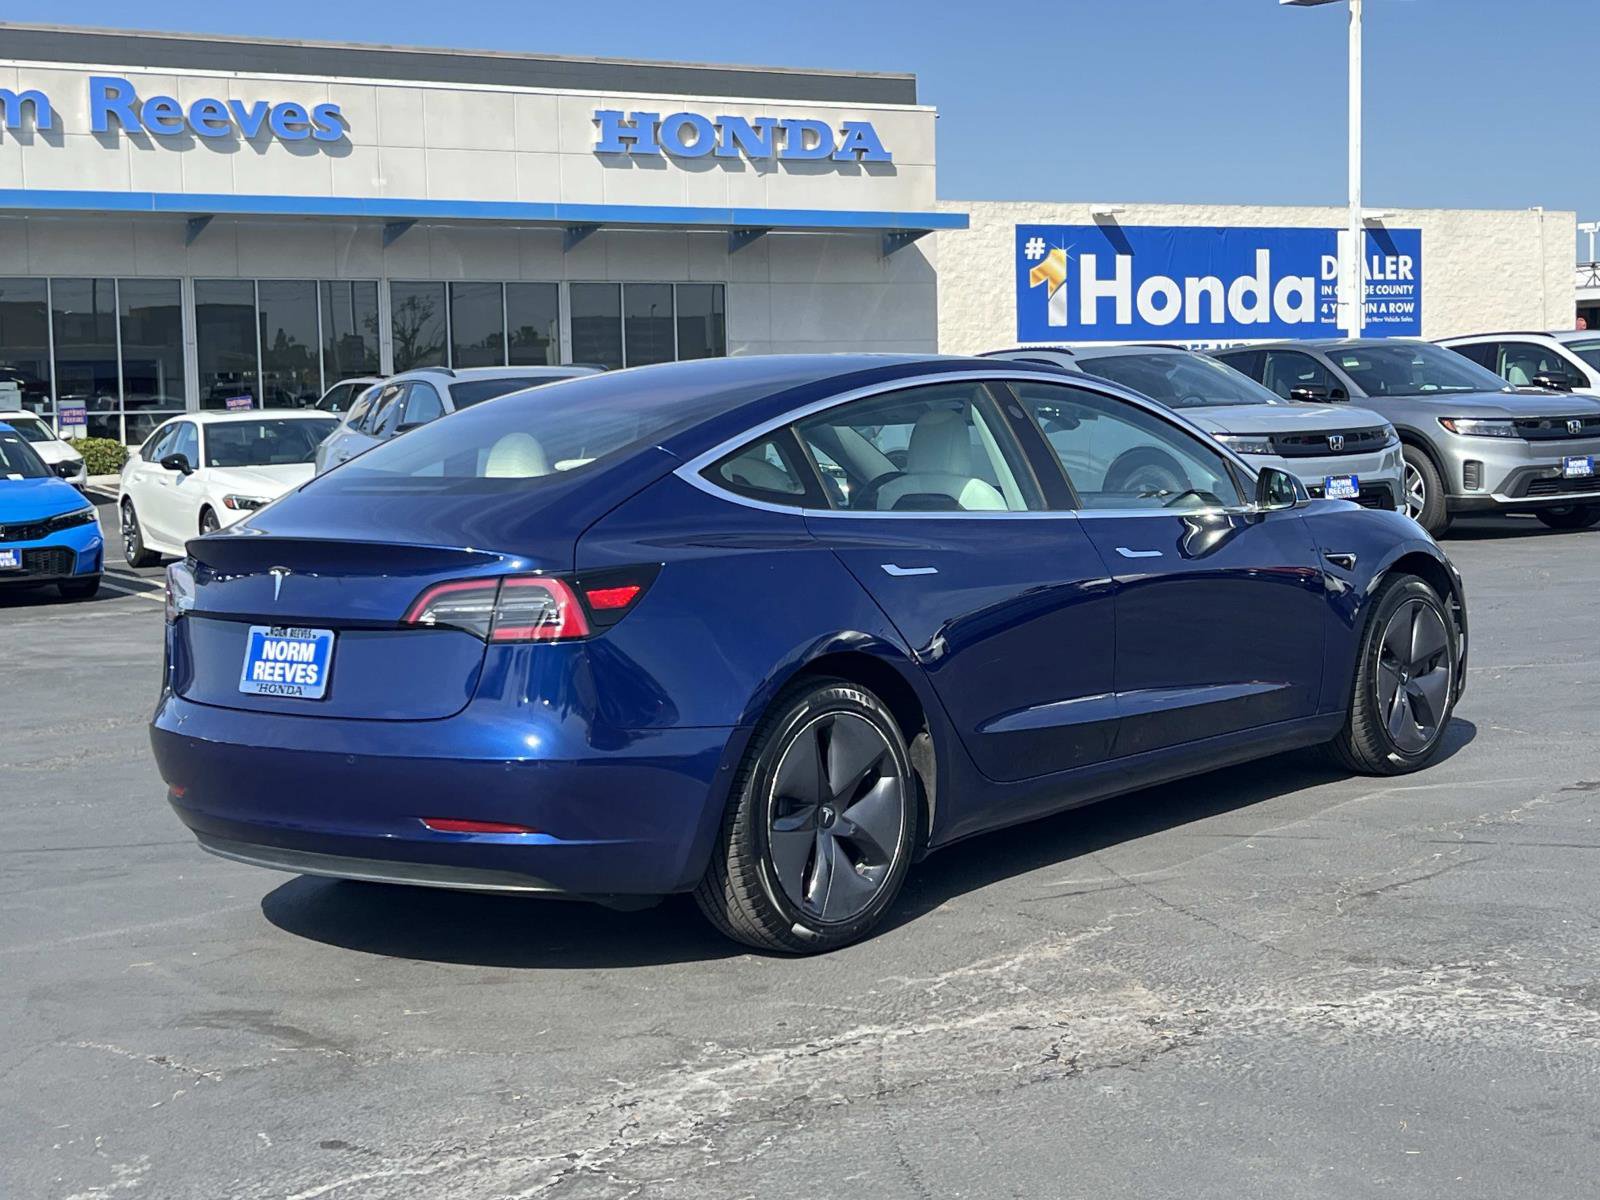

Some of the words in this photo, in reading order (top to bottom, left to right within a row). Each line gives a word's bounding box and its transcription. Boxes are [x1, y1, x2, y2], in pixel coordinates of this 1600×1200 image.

[89, 76, 345, 142] Reeves
[594, 110, 893, 162] HONDA
[1080, 249, 1315, 326] Honda
[1321, 285, 1333, 295] IN
[1376, 285, 1414, 295] COUNTY
[1321, 304, 1329, 313] 4
[1380, 303, 1387, 313] A
[1389, 303, 1415, 313] ROW
[262, 640, 316, 662] NORM
[252, 661, 319, 684] REEVES
